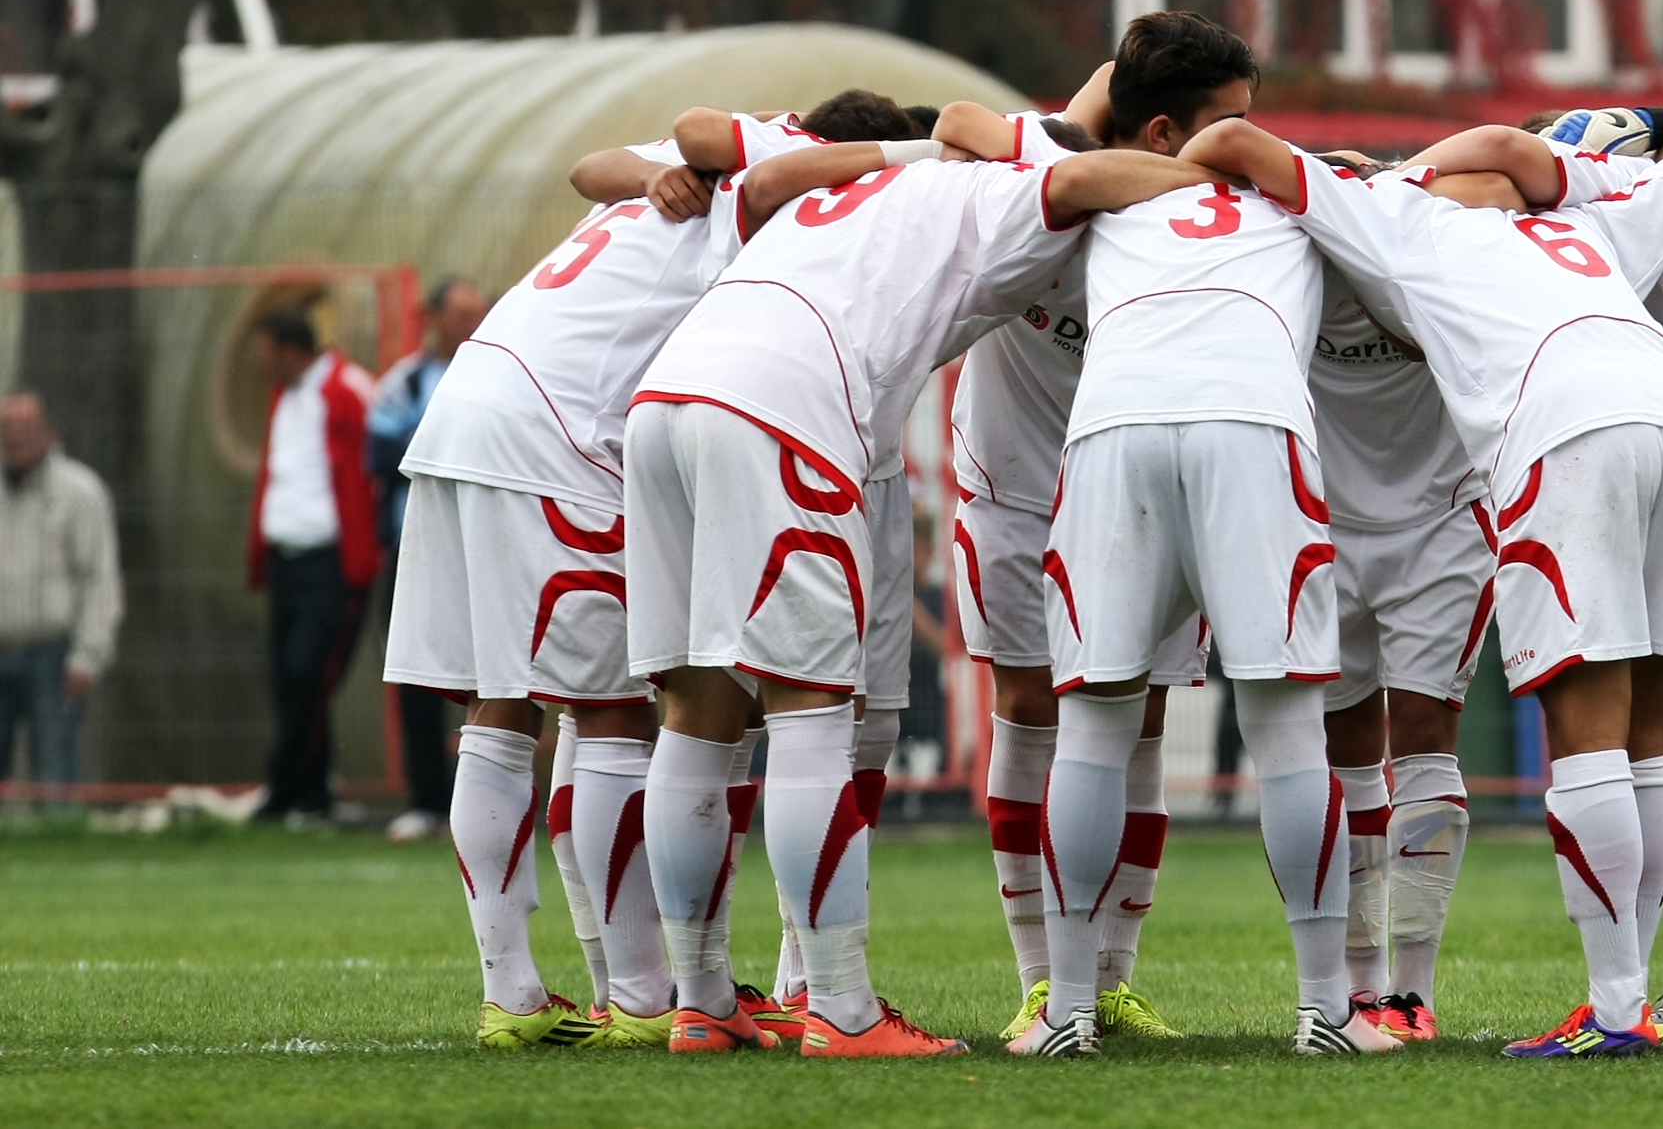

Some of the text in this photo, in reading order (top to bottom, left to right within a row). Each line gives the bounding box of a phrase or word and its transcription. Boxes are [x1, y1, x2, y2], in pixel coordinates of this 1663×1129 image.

[795, 163, 907, 227] 9
[1168, 182, 1242, 240] 3
[1513, 217, 1612, 277] 6
